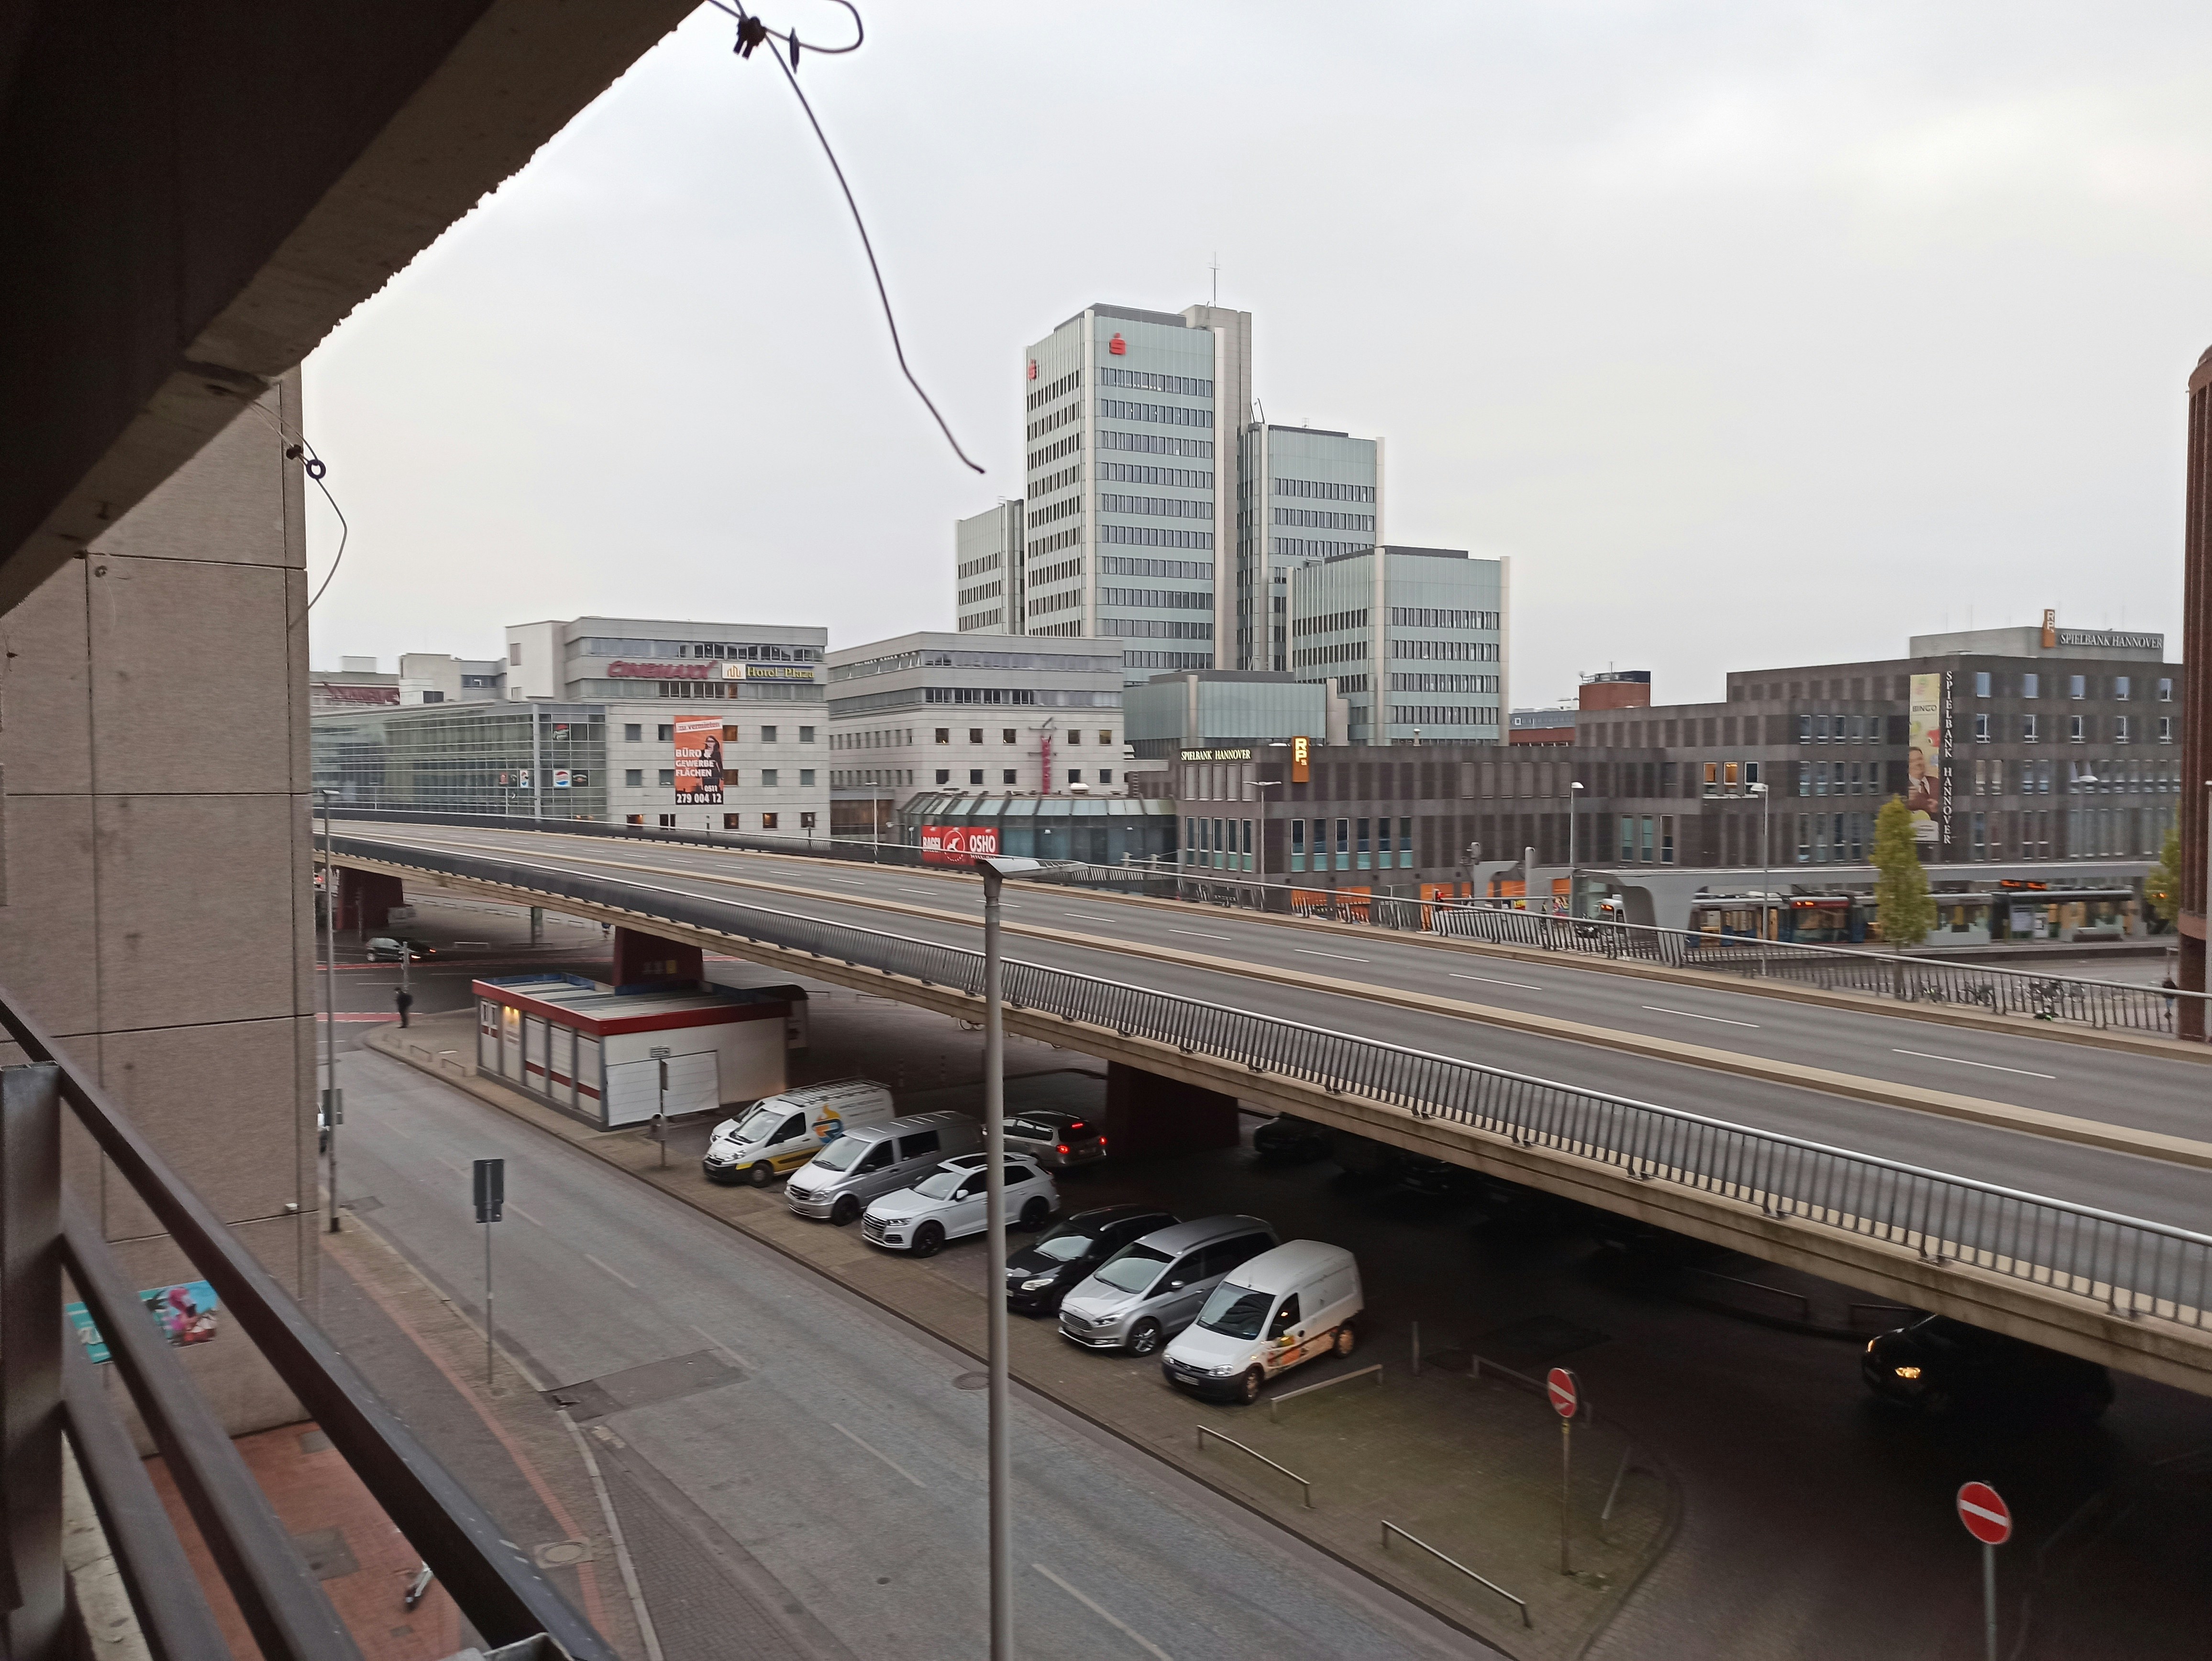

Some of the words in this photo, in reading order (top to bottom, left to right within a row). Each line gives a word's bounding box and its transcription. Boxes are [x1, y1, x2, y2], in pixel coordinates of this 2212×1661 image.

[2060, 633, 2111, 646] SPIELBANK
[2112, 635, 2163, 649] HANNOVER
[747, 666, 778, 677] Hotel
[1945, 671, 1953, 758] SPIELBANK
[675, 747, 702, 758] BÜRO
[704, 749, 711, 758] &
[1181, 750, 1213, 761] SPIELBANK
[1215, 749, 1251, 760] HANNOVER
[675, 767, 712, 777] FLÄCHEN
[677, 793, 692, 803] 279
[694, 793, 709, 803] 004
[713, 793, 722, 803] 12
[1943, 767, 1952, 844] HANNOVER
[969, 835, 996, 853] OSHO
